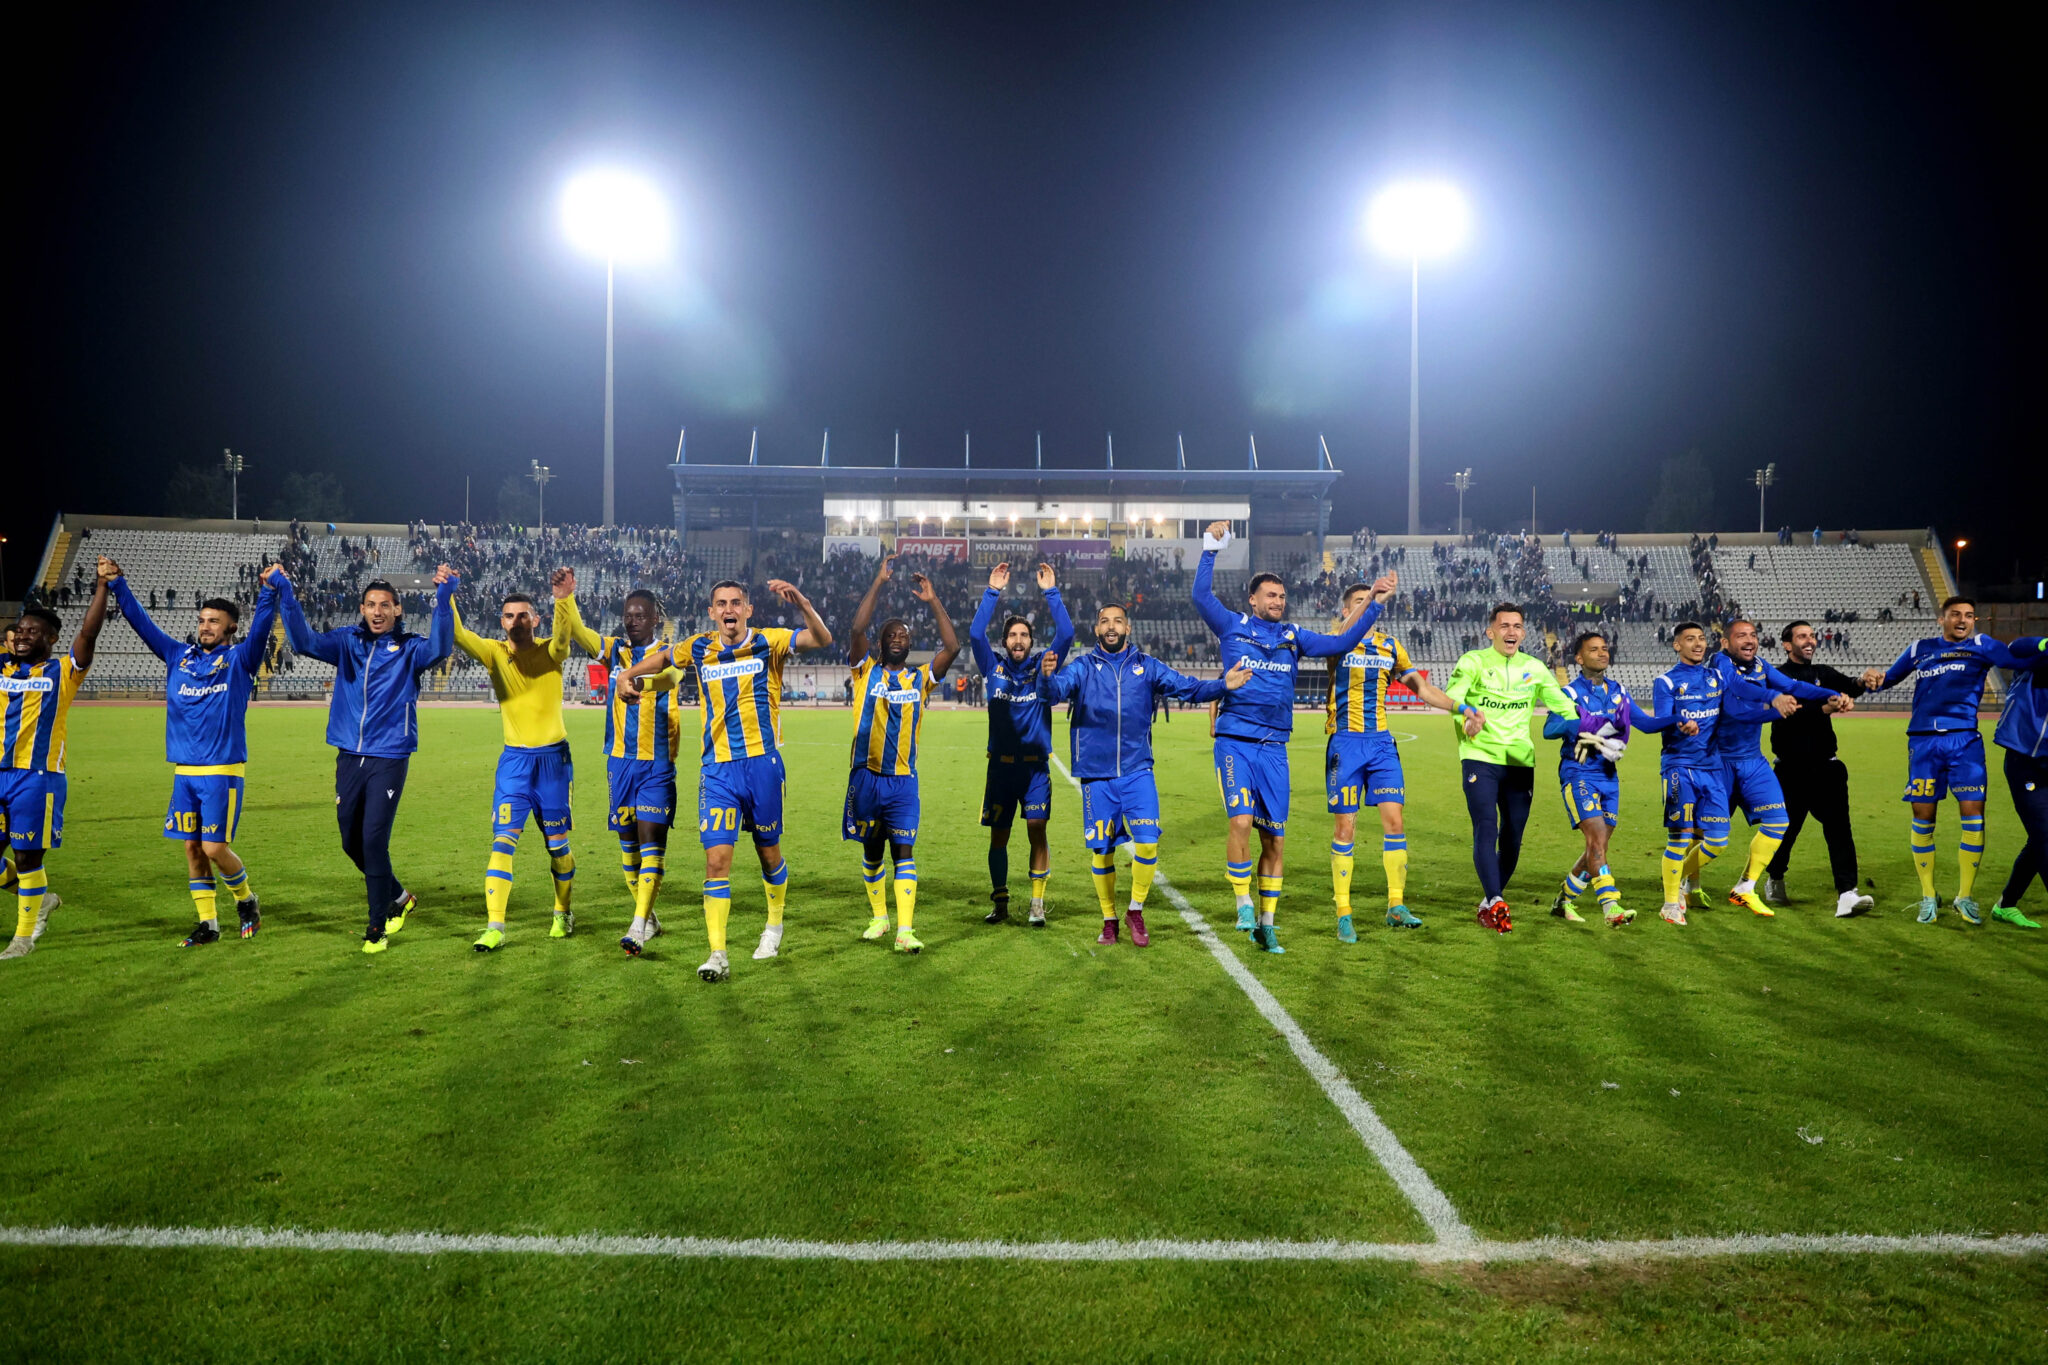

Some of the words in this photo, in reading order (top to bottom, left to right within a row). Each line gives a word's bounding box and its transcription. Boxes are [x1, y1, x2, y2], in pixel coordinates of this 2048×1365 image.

[901, 542, 963, 556] FONBET
[975, 543, 1034, 551] KORANTINA
[702, 661, 762, 679] Stoiximan
[1240, 655, 1292, 672] Stoiximan
[1345, 653, 1393, 667] Stoixima
[1225, 755, 1235, 787] DIMCO
[1330, 753, 1340, 786] DIMO
[1911, 778, 1936, 797] 35
[847, 785, 856, 818] DIMCO
[174, 811, 197, 833] 10
[498, 803, 511, 824] 9
[709, 807, 737, 831] 70
